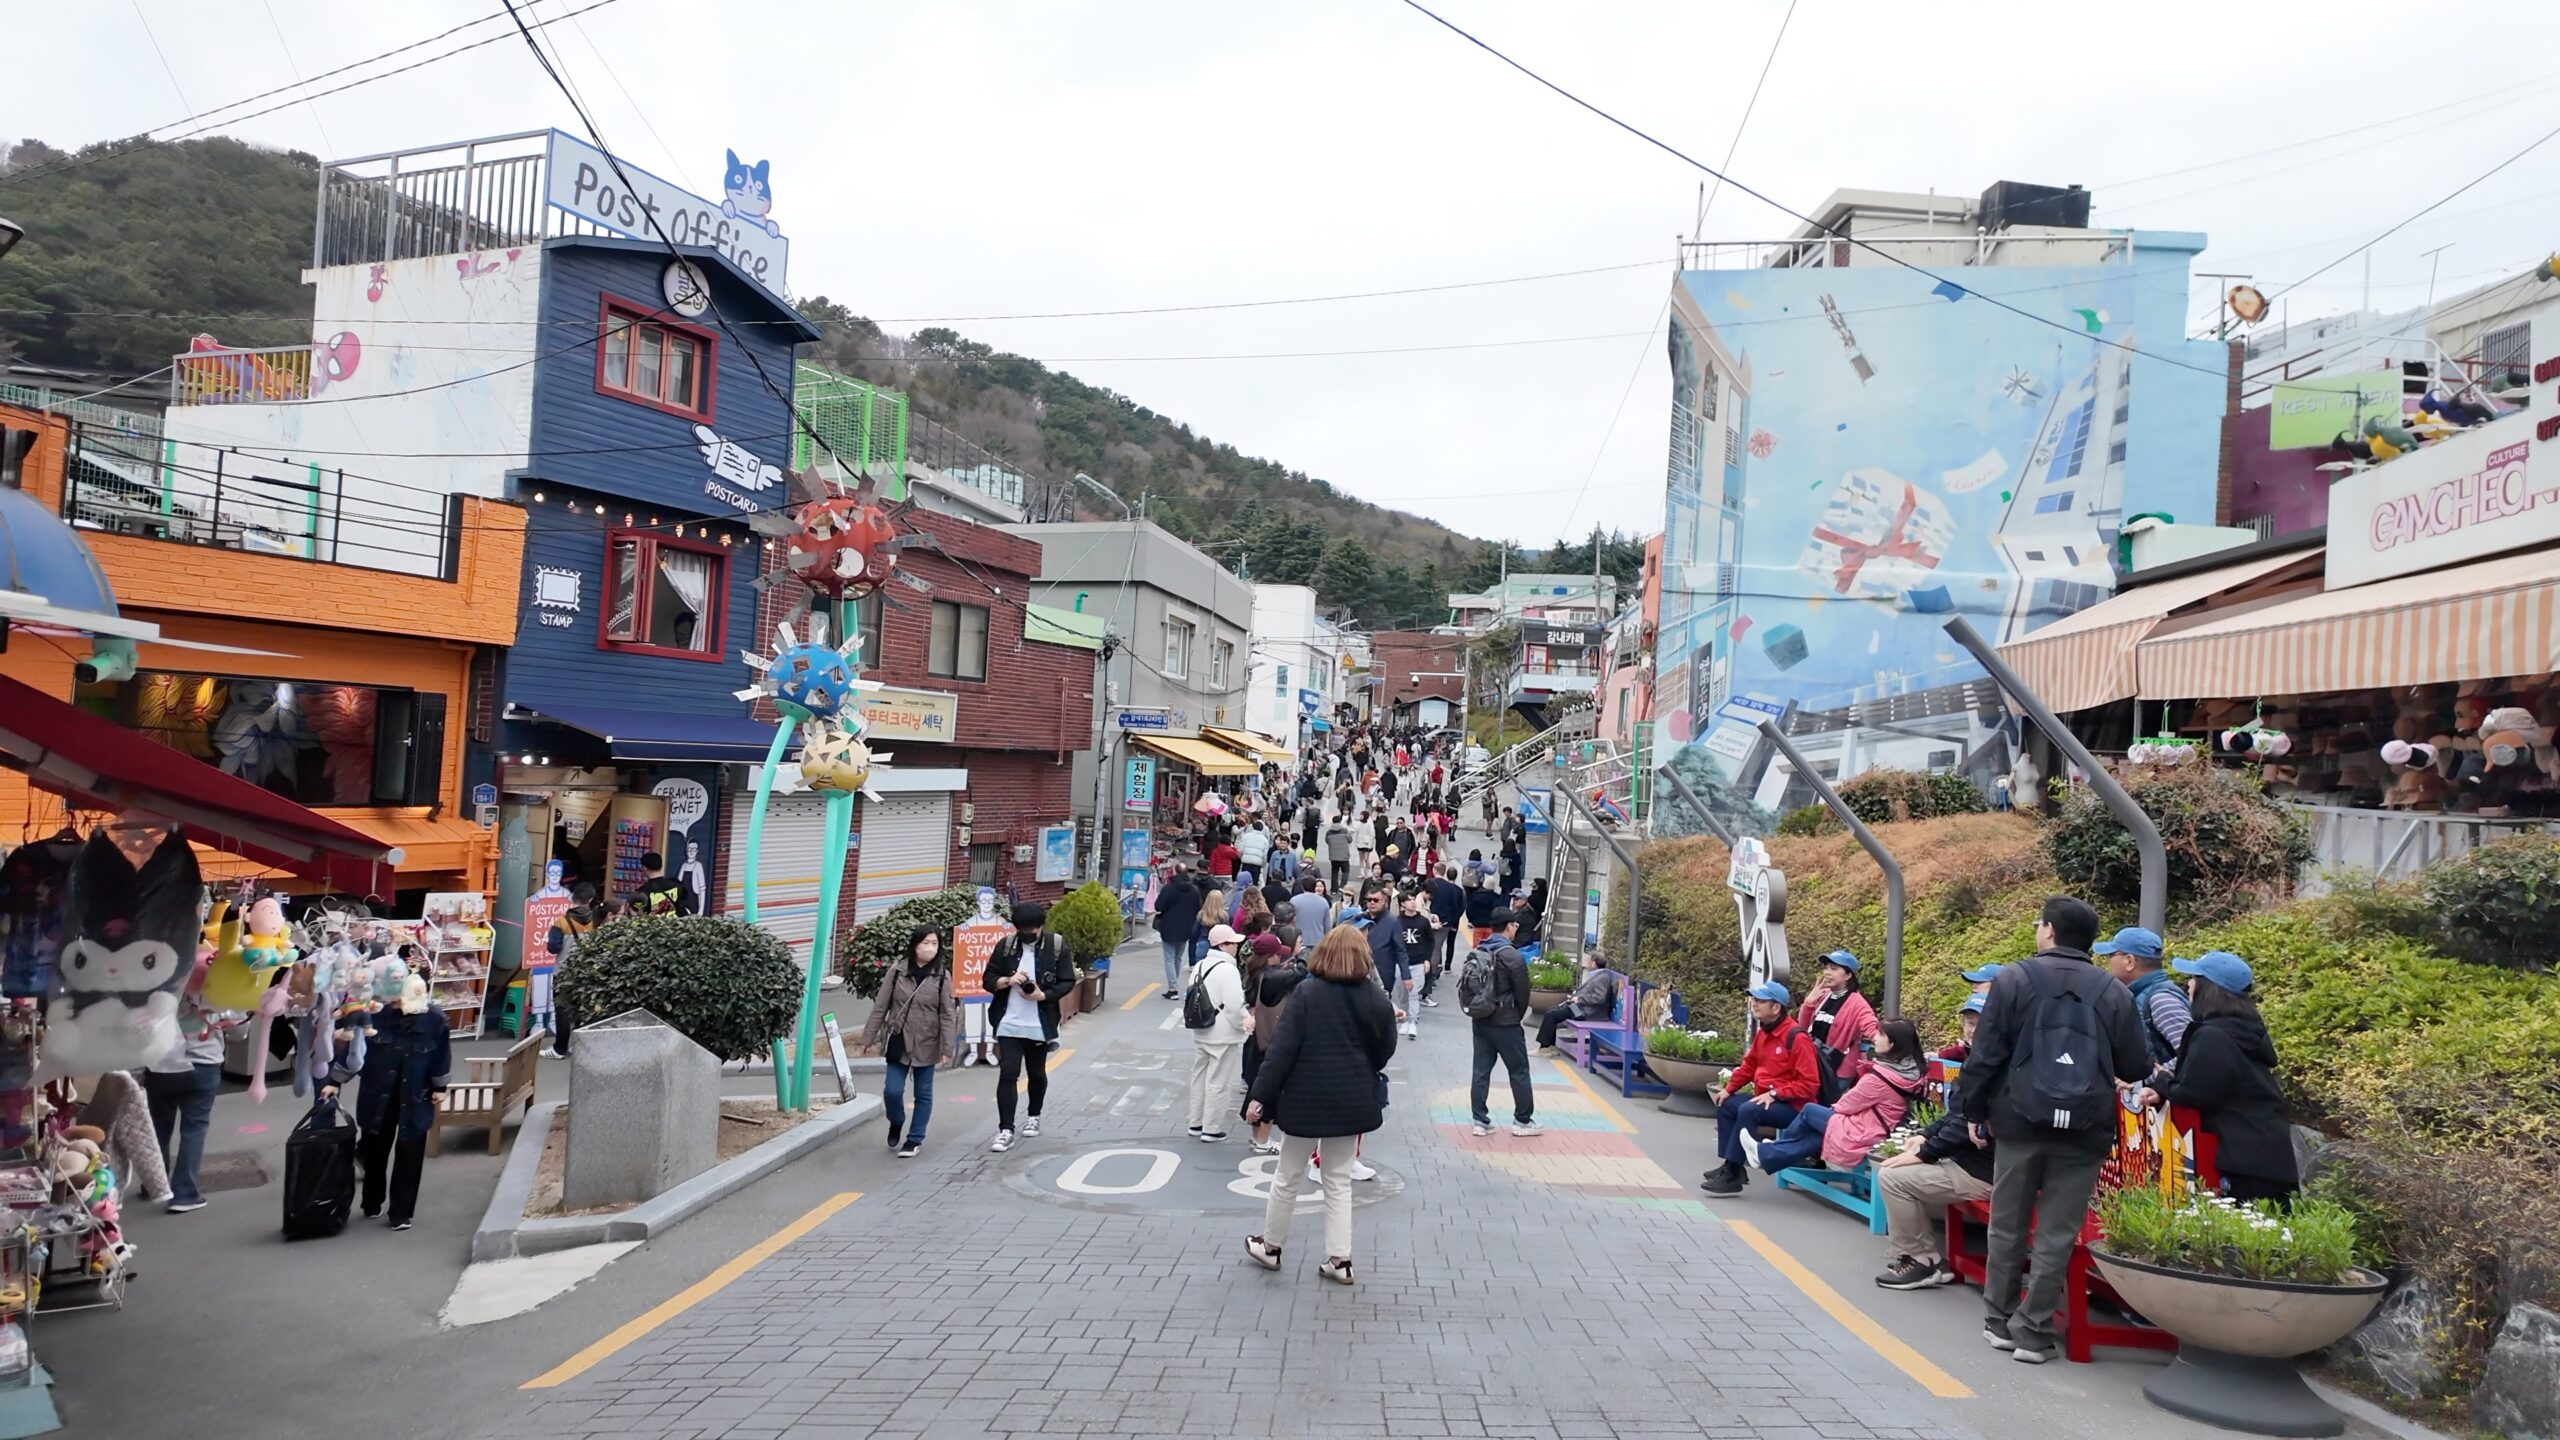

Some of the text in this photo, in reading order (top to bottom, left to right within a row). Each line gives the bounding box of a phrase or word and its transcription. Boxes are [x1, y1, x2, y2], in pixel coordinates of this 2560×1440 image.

[574, 161, 660, 236] Post
[2280, 396, 2329, 416] REST
[2487, 444, 2527, 468] CULTURE
[704, 479, 759, 513] POSTCARD
[539, 612, 574, 628] STAMP
[1546, 631, 1585, 645] 감내카페
[859, 707, 944, 733] 푸터크리닝 세탁
[1132, 761, 1147, 799] 체험장
[656, 786, 702, 800] CERAMIC
[670, 800, 702, 815] GNET
